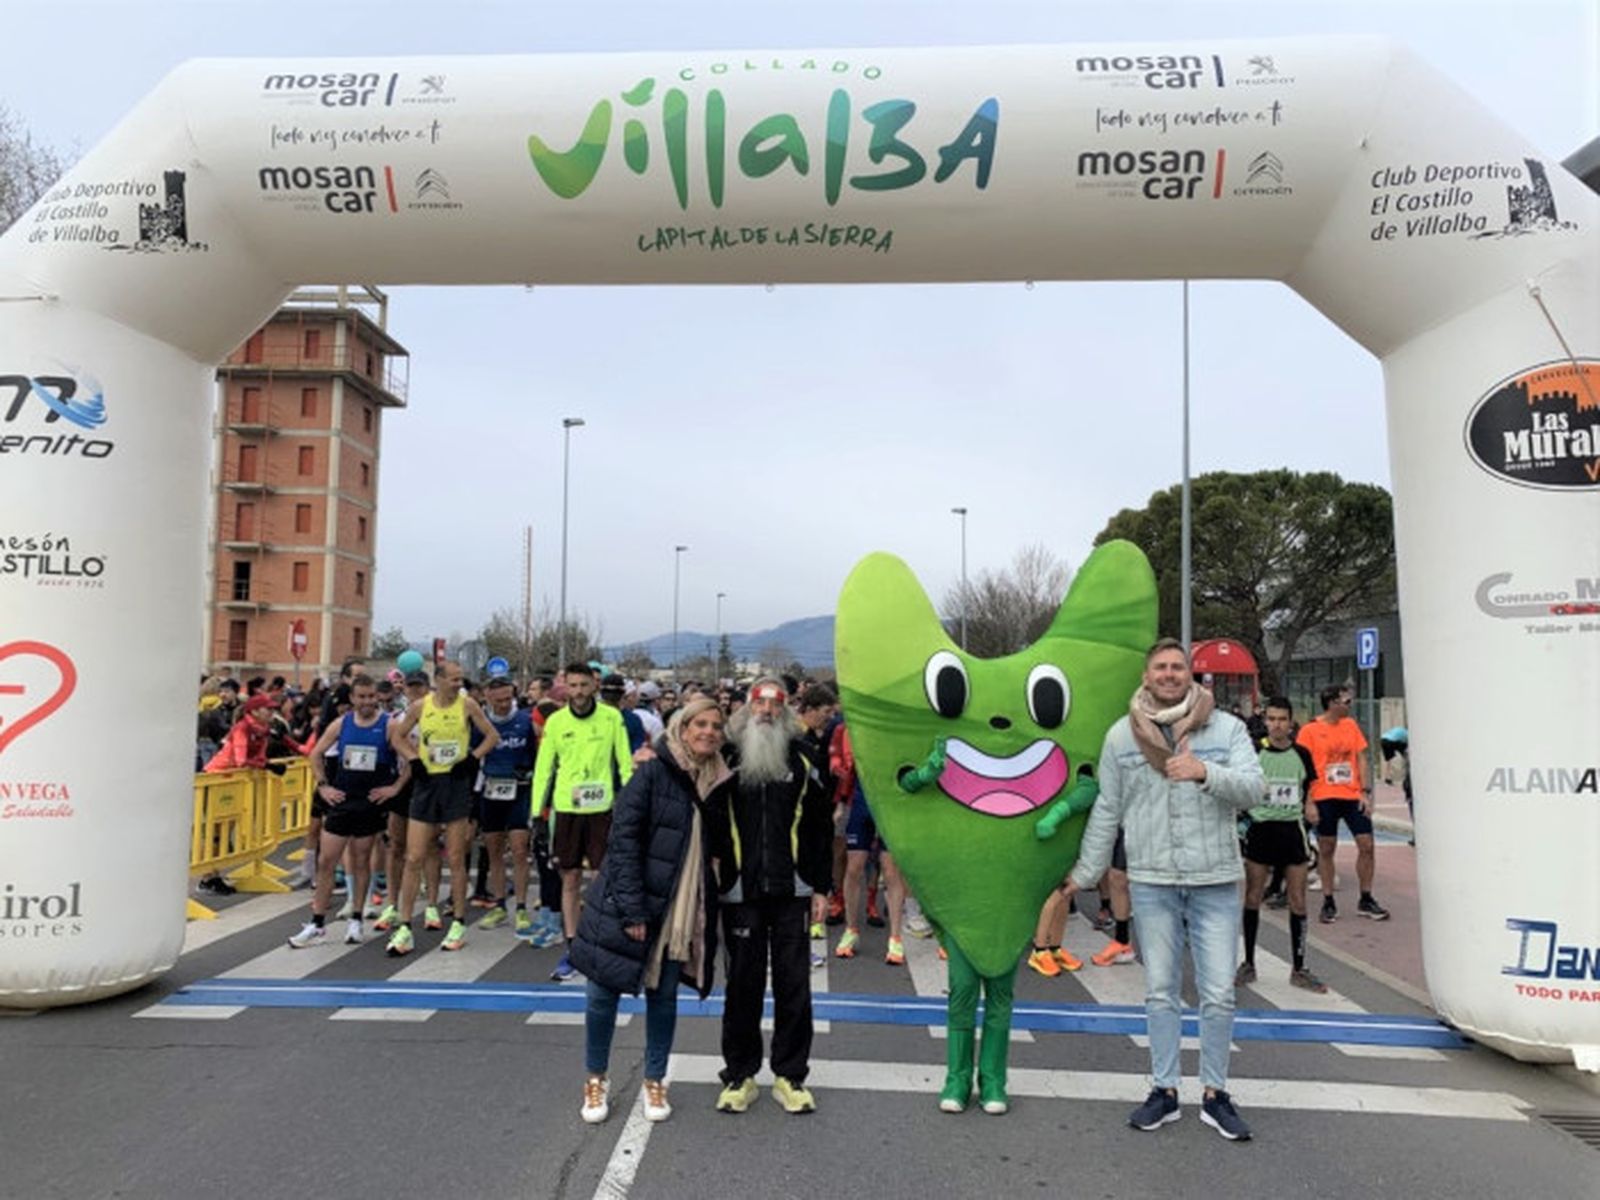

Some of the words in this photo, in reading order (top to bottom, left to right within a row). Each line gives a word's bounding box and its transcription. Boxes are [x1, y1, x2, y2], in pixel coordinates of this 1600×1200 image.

[679, 59, 883, 82] COLLADO
[1076, 56, 1203, 72] mosan
[264, 73, 380, 90] mosan
[1144, 70, 1203, 89] car
[321, 88, 376, 107] car
[1077, 150, 1206, 176] mosan
[259, 166, 376, 190] mosan
[1371, 165, 1417, 189] Club
[1424, 162, 1522, 184] Deportivo
[74, 179, 157, 198] Deportivo
[1143, 176, 1204, 199] car
[50, 202, 109, 221] Castillo
[325, 191, 377, 213] car
[1371, 194, 1388, 216] El
[1396, 187, 1474, 212] Castillo
[28, 226, 49, 244] de
[53, 224, 120, 244] Villalba
[741, 226, 769, 245] DE
[804, 223, 894, 253] SIERRA
[1370, 222, 1398, 241] de
[1406, 214, 1488, 238] Villalba
[1532, 411, 1569, 433] Las
[1503, 425, 1600, 463] Mural
[0, 553, 105, 578] STILLO
[1361, 633, 1375, 664] P
[17, 782, 70, 801] VEGA
[2, 881, 83, 920] irol
[1515, 984, 1563, 1000] TODO
